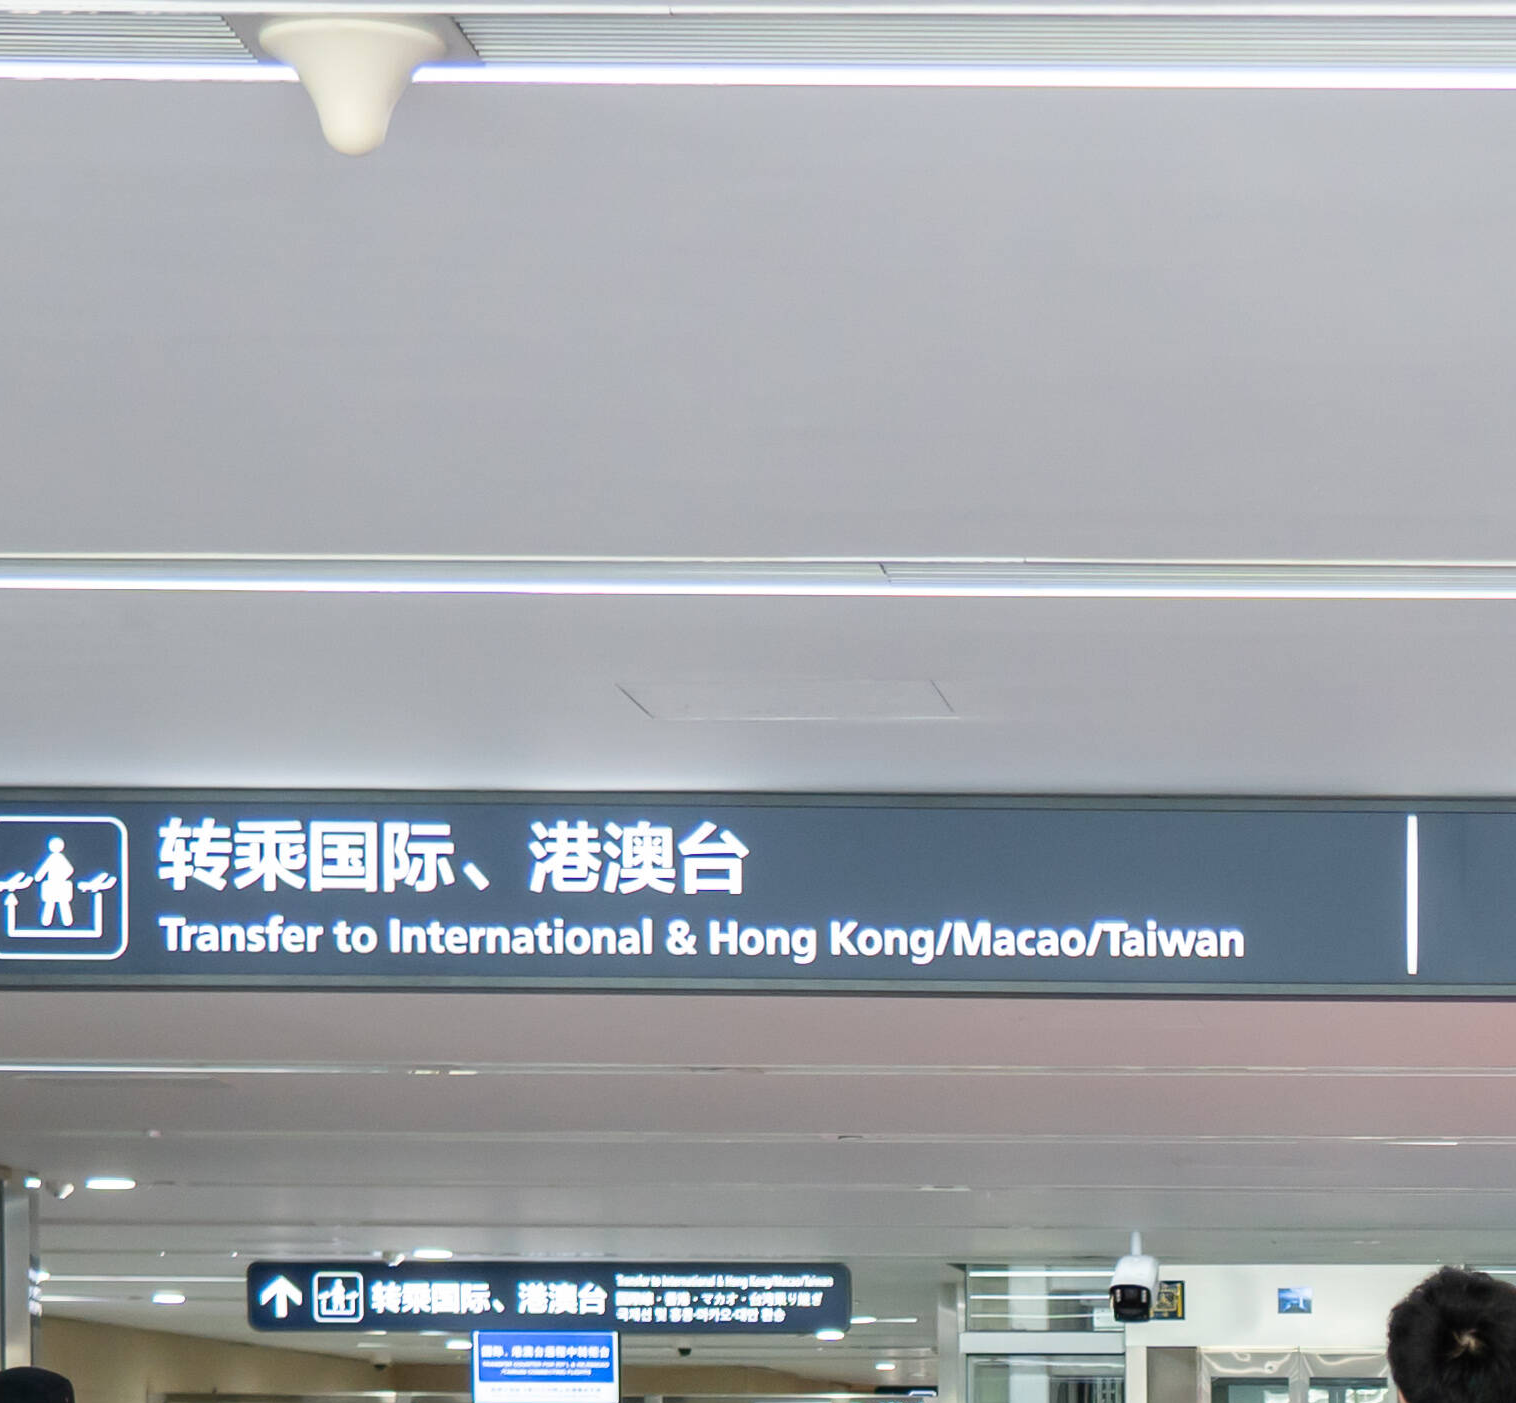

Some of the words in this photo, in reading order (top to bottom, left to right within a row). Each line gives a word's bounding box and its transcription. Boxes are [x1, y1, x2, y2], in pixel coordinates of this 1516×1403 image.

[159, 817, 751, 897] 转乘国际、港澳台
[159, 915, 325, 960] Transfer
[333, 918, 379, 960] to
[388, 915, 654, 962] International
[665, 919, 698, 962] &
[709, 918, 819, 970] Hong
[829, 918, 1246, 970] Kong/Macao/Taiwan
[371, 1281, 608, 1316] 转乘国际、港澳台
